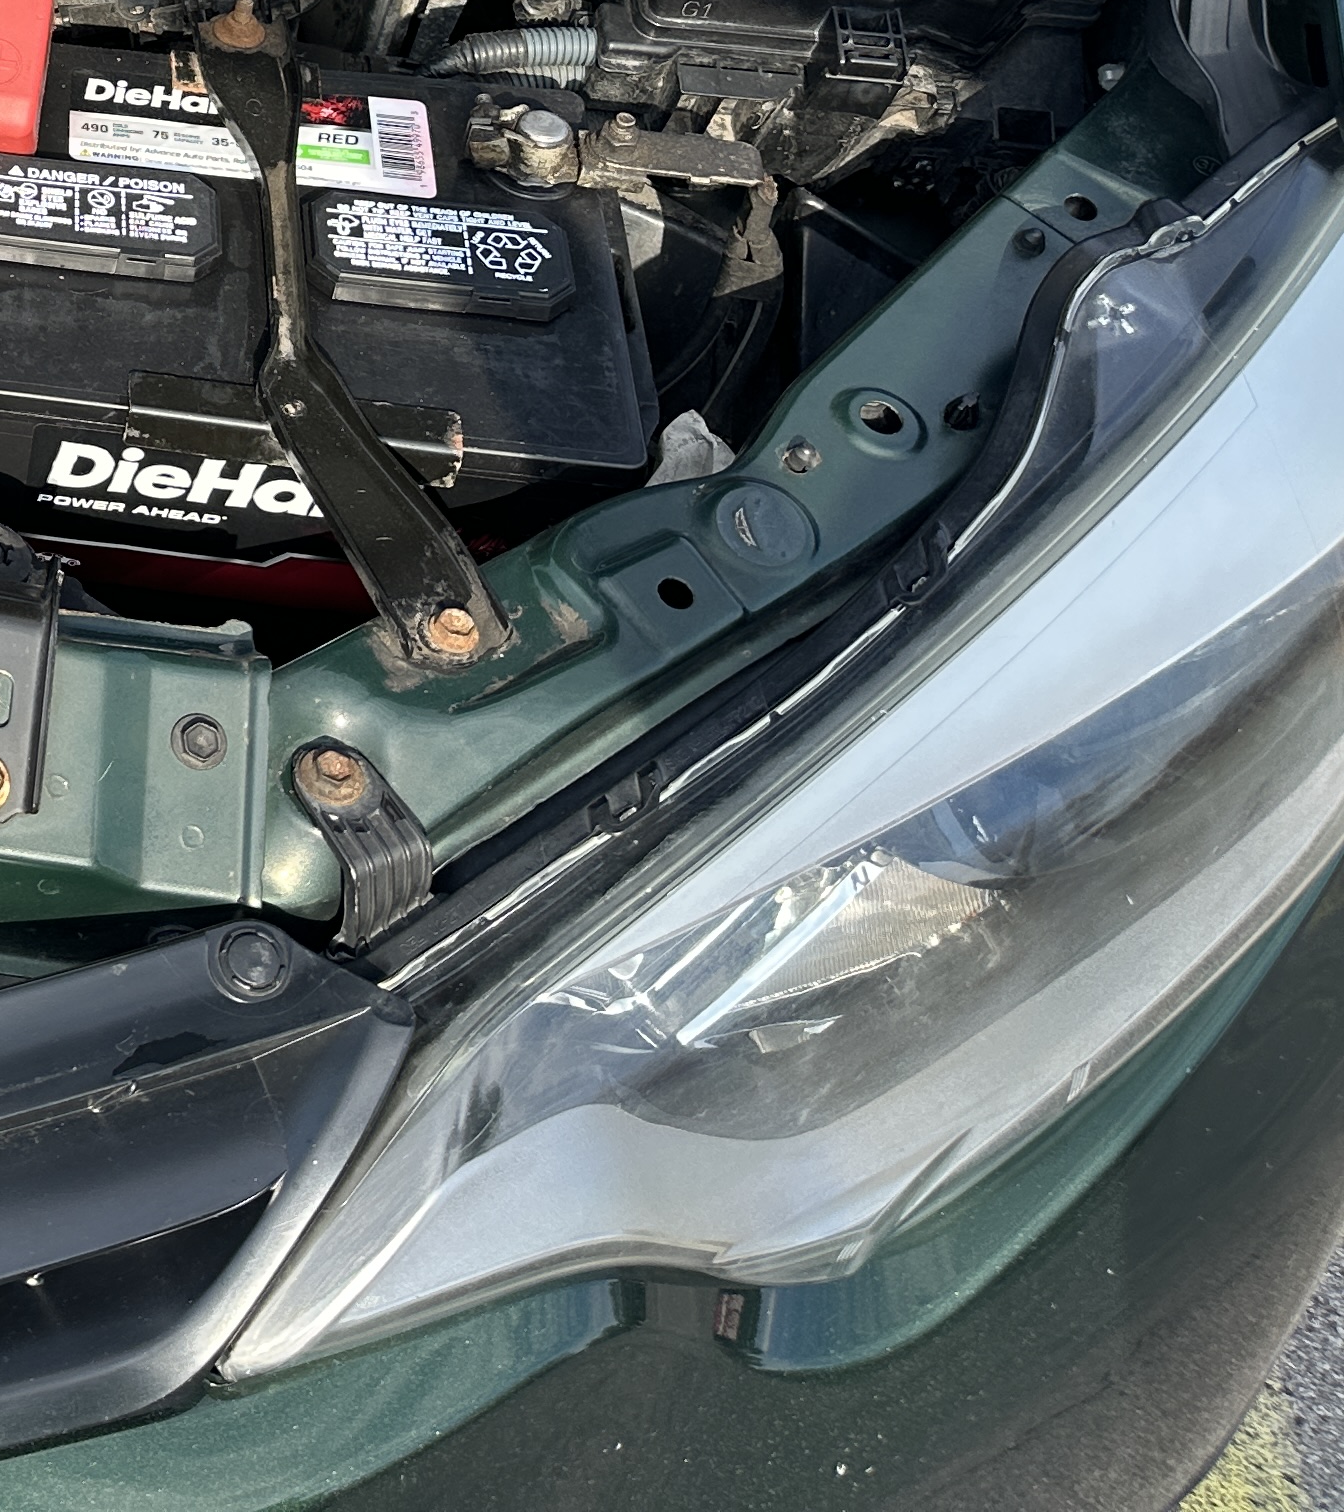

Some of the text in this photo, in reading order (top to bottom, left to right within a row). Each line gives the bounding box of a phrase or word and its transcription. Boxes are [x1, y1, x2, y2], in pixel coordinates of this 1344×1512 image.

[682, 0, 712, 19] G1
[80, 122, 109, 134] 490
[152, 130, 169, 140] 75
[317, 132, 360, 146] RED
[80, 140, 128, 151] Distributed
[144, 147, 181, 158] Advance
[183, 151, 204, 161] Auto
[27, 167, 100, 185] DANGER
[118, 177, 186, 194] POISON
[352, 205, 369, 213] NOT
[413, 211, 434, 219] VENT
[462, 216, 486, 225] TIGHT
[488, 219, 506, 227] AND
[377, 202, 395, 210] OUT
[396, 203, 409, 211] OF
[410, 205, 427, 213] THE
[430, 207, 458, 216] REACH
[459, 210, 471, 218] OF
[473, 211, 514, 221] CHILDREN
[362, 215, 388, 226] FLUSH
[389, 218, 410, 228] EYES
[399, 234, 421, 243] HELP
[422, 236, 442, 246] FAST
[494, 271, 533, 282] RECYCLE
[36, 493, 126, 513] POWER
